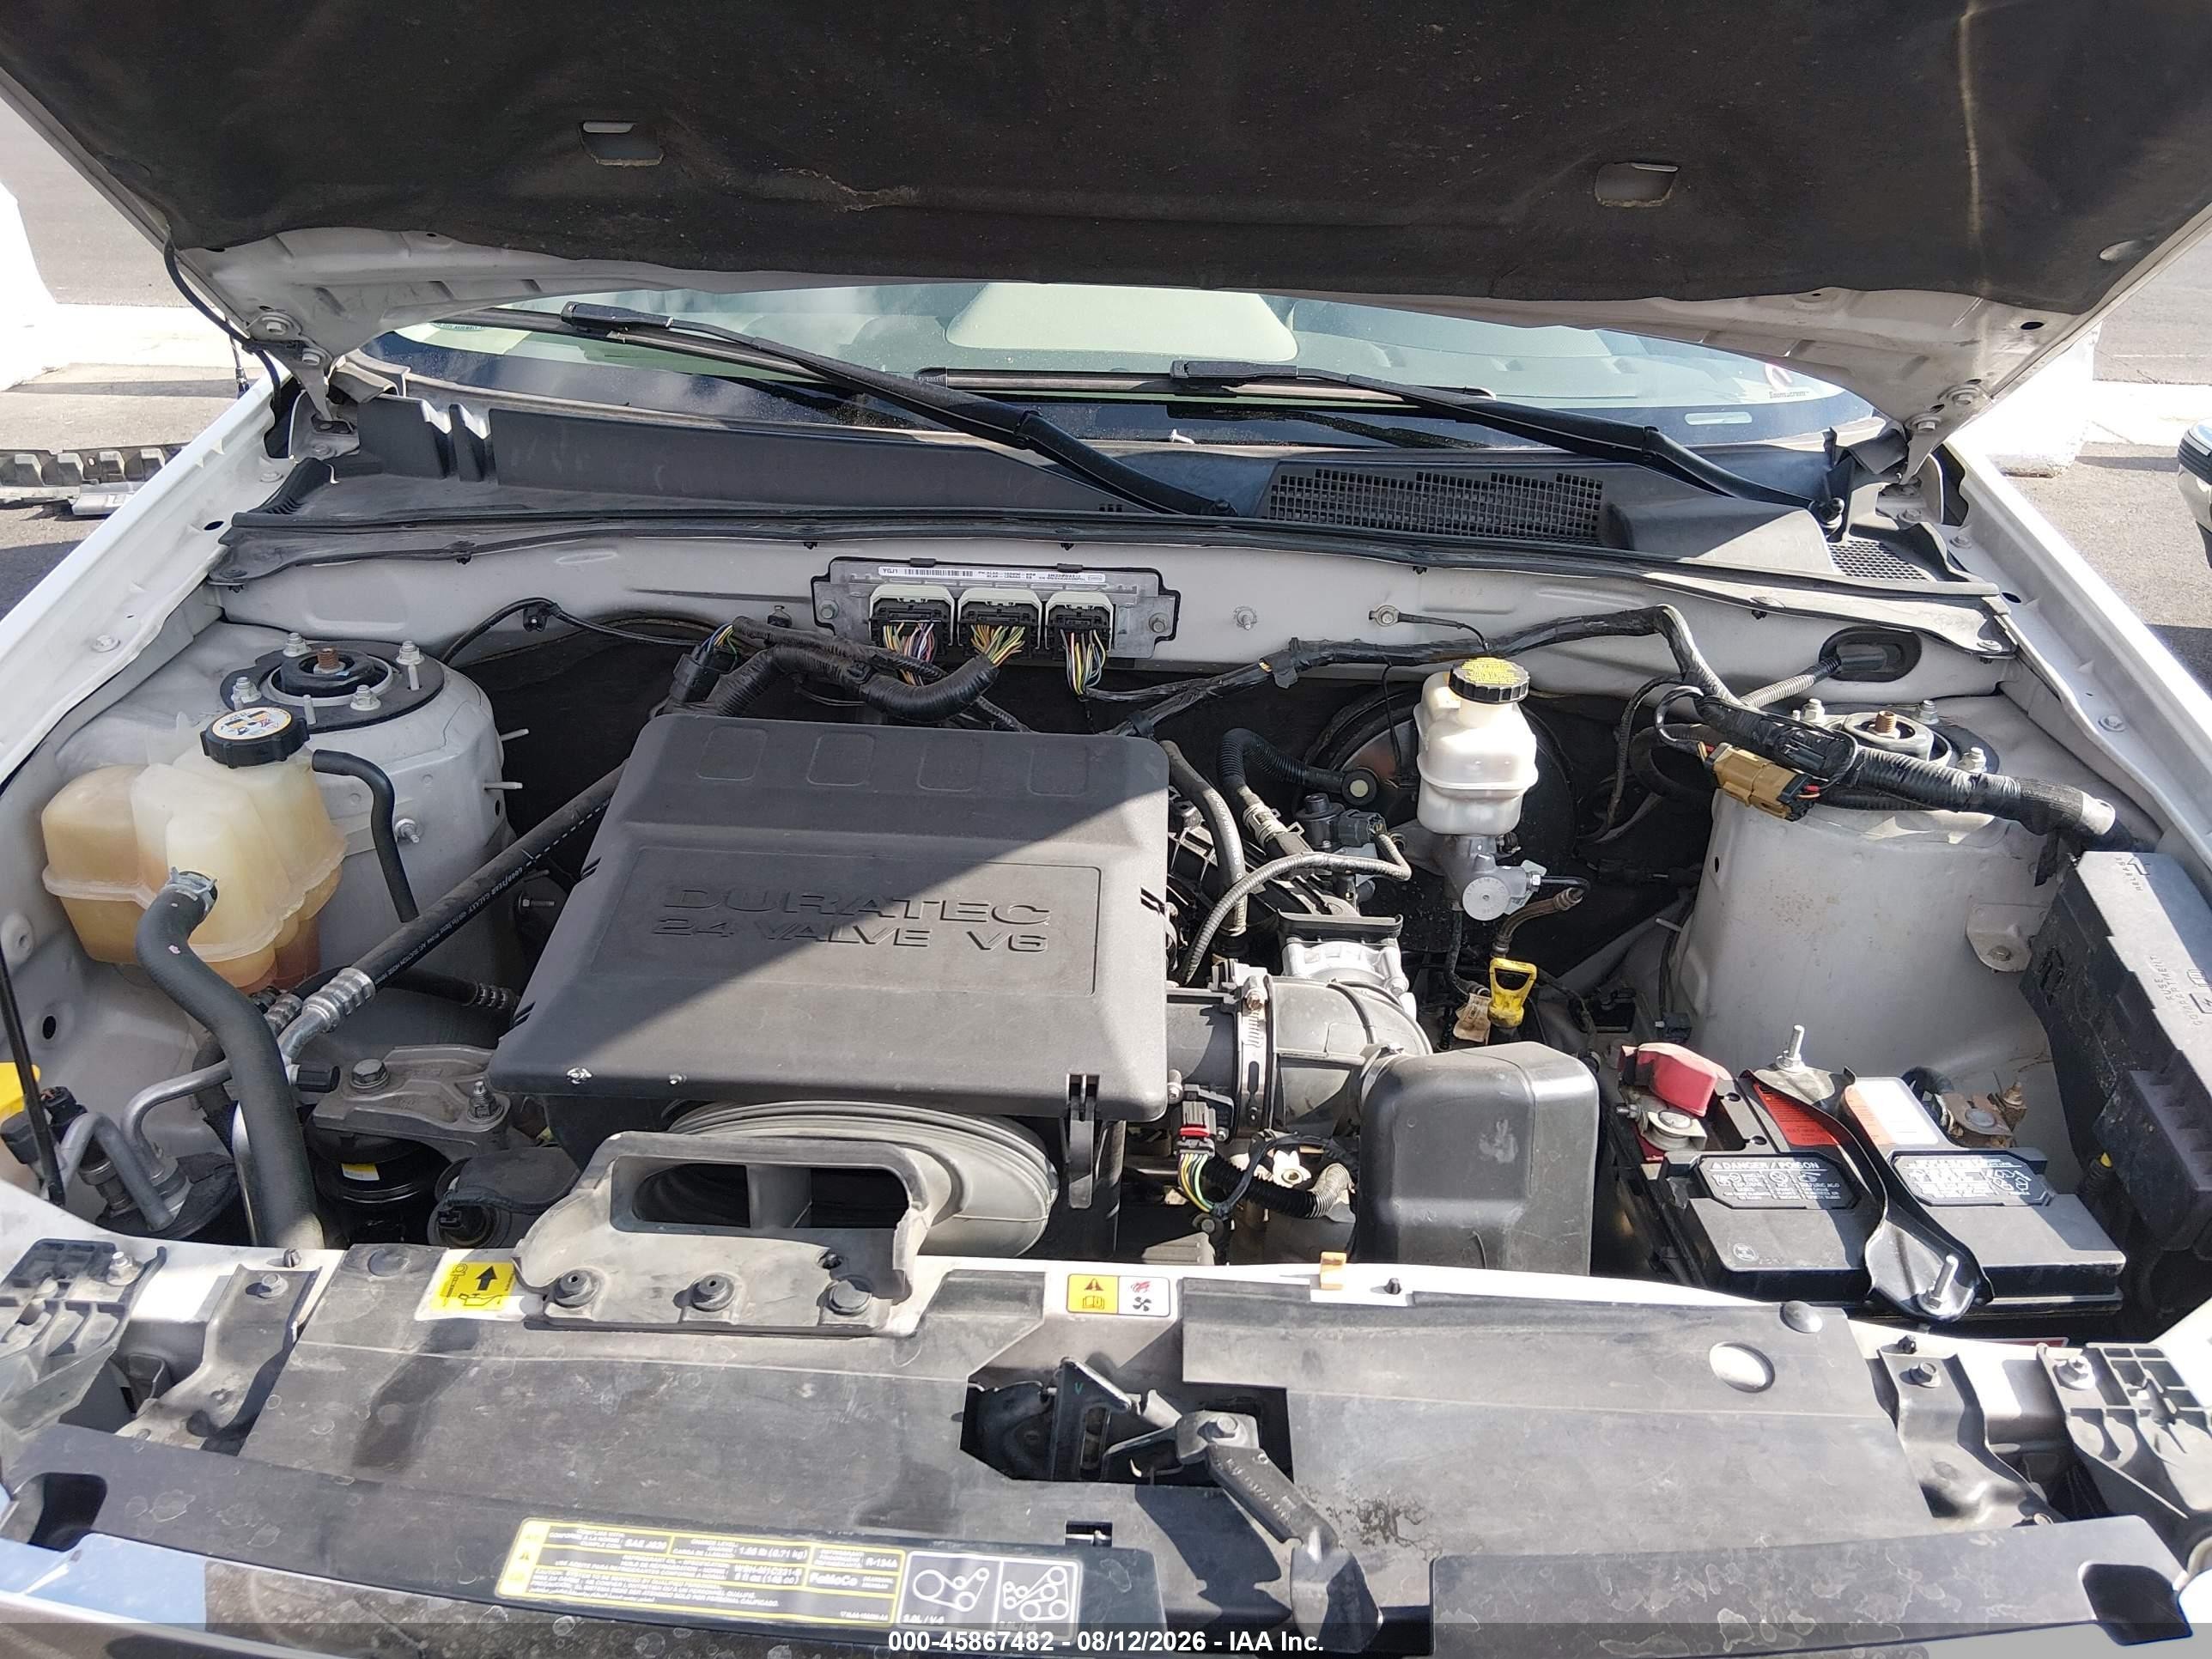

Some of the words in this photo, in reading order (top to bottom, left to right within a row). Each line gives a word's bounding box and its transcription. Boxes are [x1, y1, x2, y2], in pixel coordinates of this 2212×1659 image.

[663, 889, 1053, 926] DURATEC
[652, 918, 735, 939] 24
[756, 921, 932, 949] VALVE
[966, 929, 1048, 954] V6
[2148, 955, 2204, 1027] COMPARTMENT
[2153, 978, 2176, 1001] FUSE
[1722, 1161, 1768, 1170] DANGER
[1778, 1161, 1820, 1170] POISON
[624, 1538, 646, 1548] SAE
[768, 1547, 791, 1559] (0.71
[791, 1548, 808, 1560] kg)
[865, 1557, 898, 1568] R-134A
[810, 1571, 859, 1587] FoMoCo
